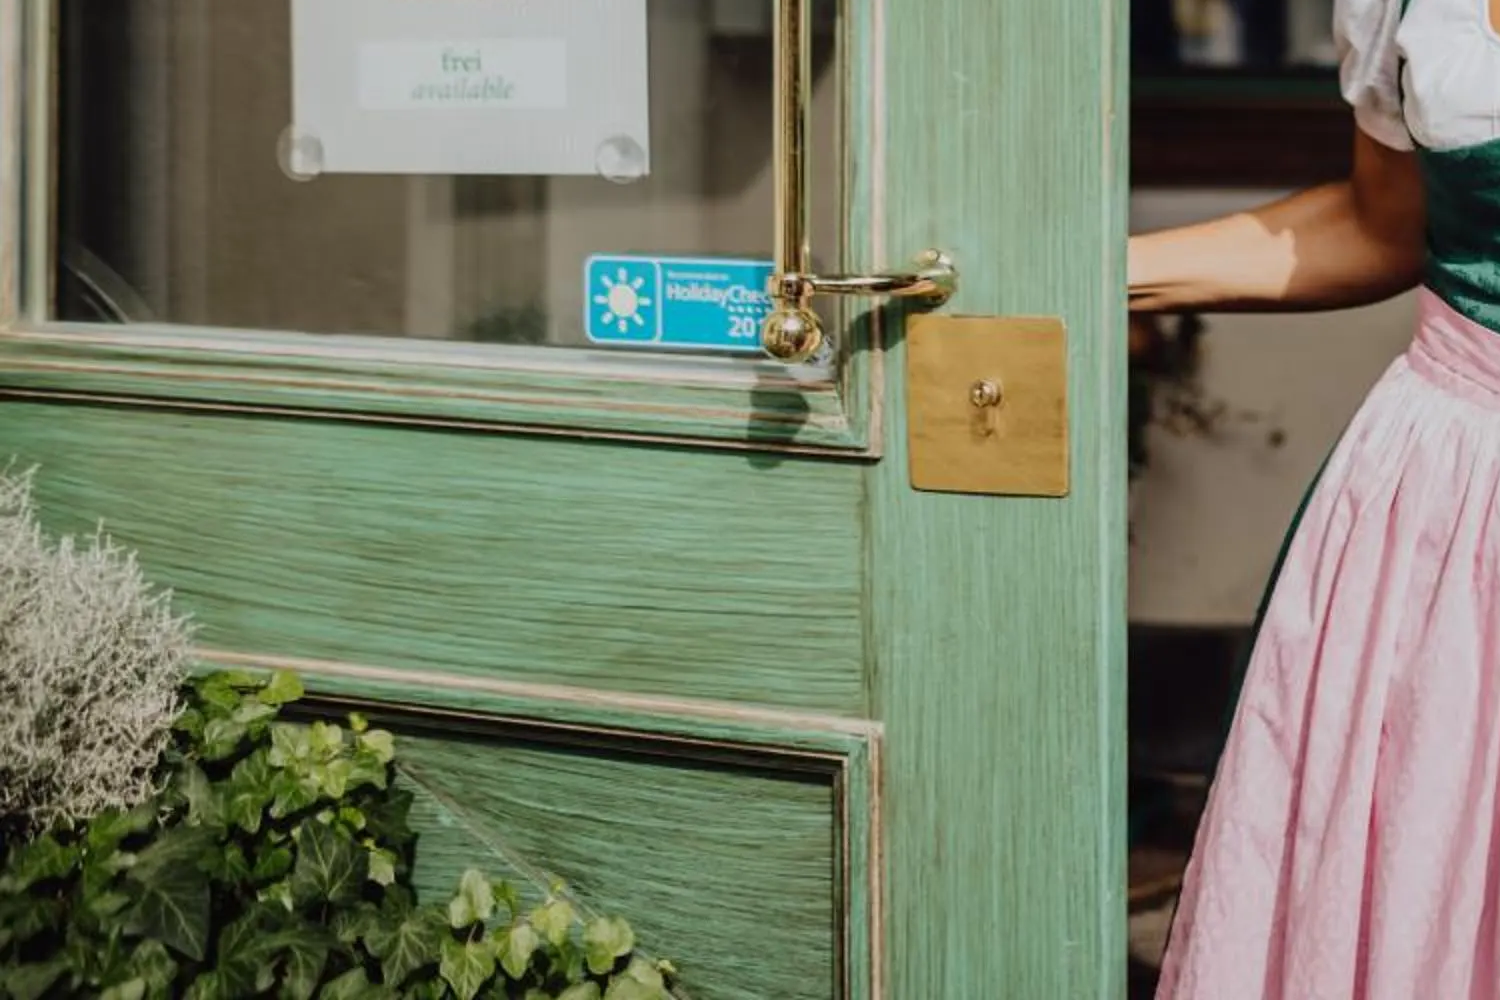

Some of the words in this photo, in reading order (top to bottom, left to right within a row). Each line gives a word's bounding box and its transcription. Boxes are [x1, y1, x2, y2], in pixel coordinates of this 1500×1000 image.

[440, 48, 483, 72] frei
[410, 76, 516, 101] available
[666, 282, 772, 308] HolidayChec
[727, 316, 767, 338] 20
